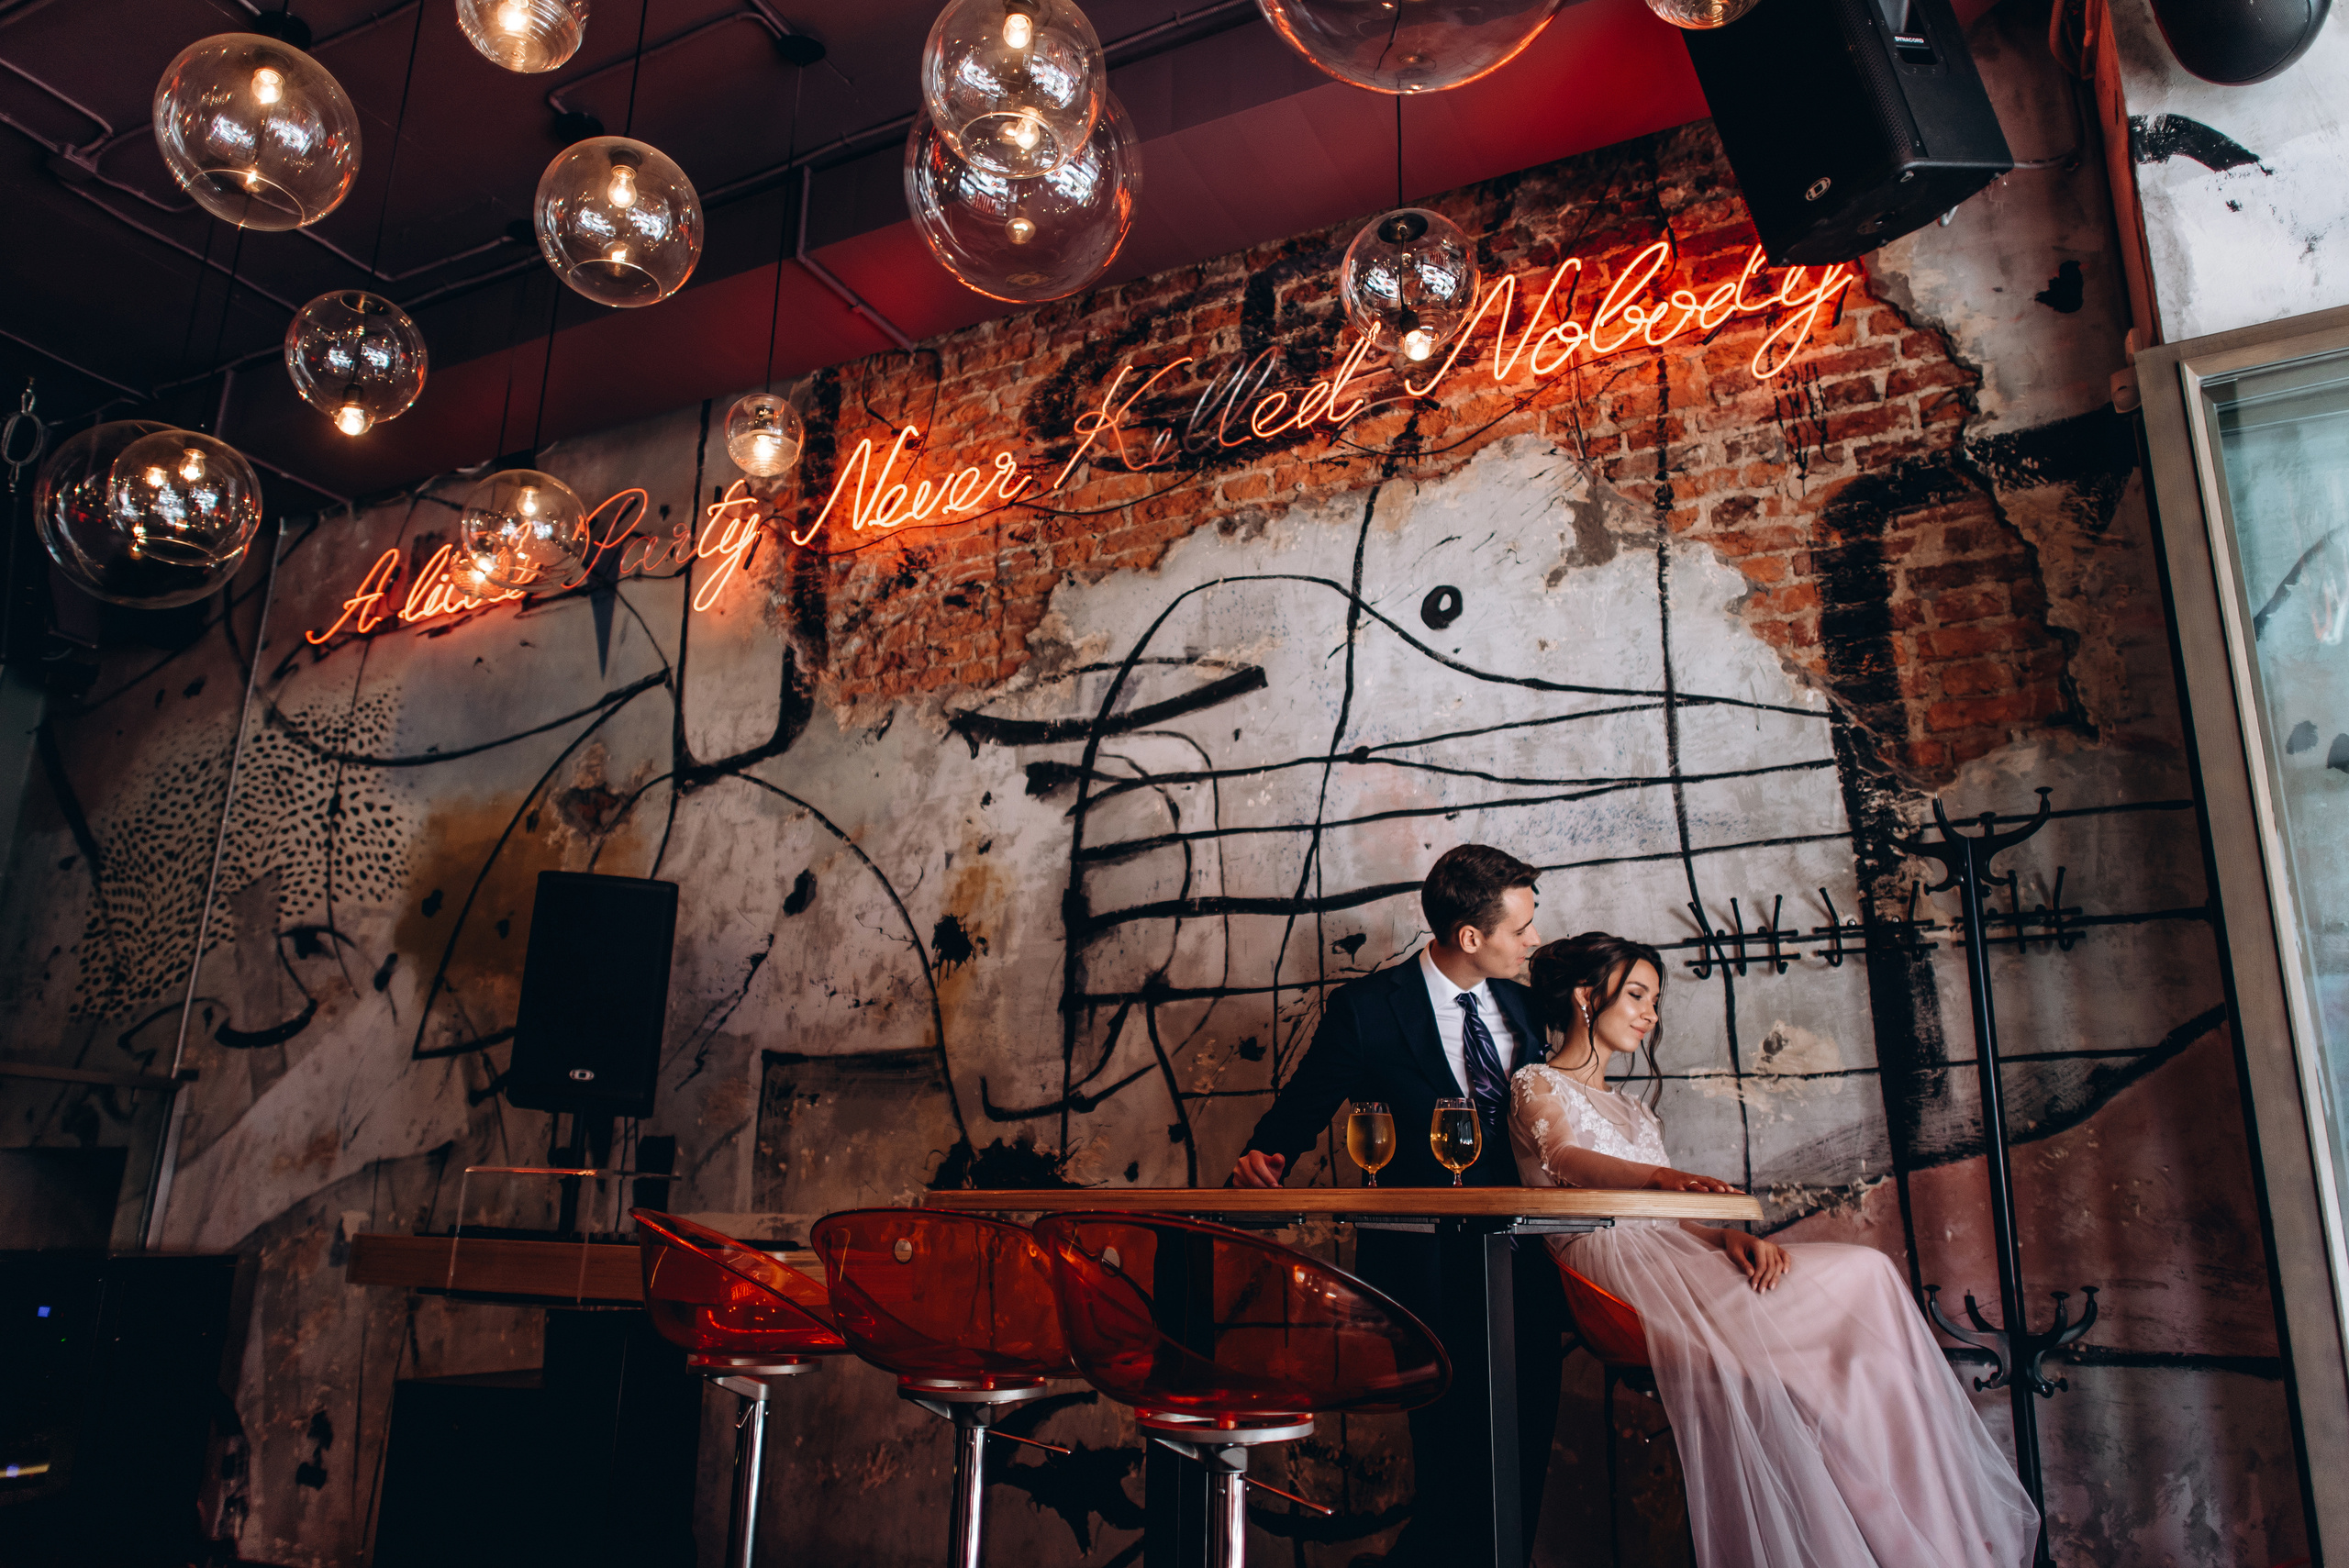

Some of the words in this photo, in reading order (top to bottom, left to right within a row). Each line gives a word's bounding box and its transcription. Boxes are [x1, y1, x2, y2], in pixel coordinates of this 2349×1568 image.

[306, 547, 401, 645] A
[560, 478, 761, 613] Party
[790, 424, 1033, 546] Never
[1053, 320, 1382, 490] Killed
[1405, 240, 1854, 396] Nobody
